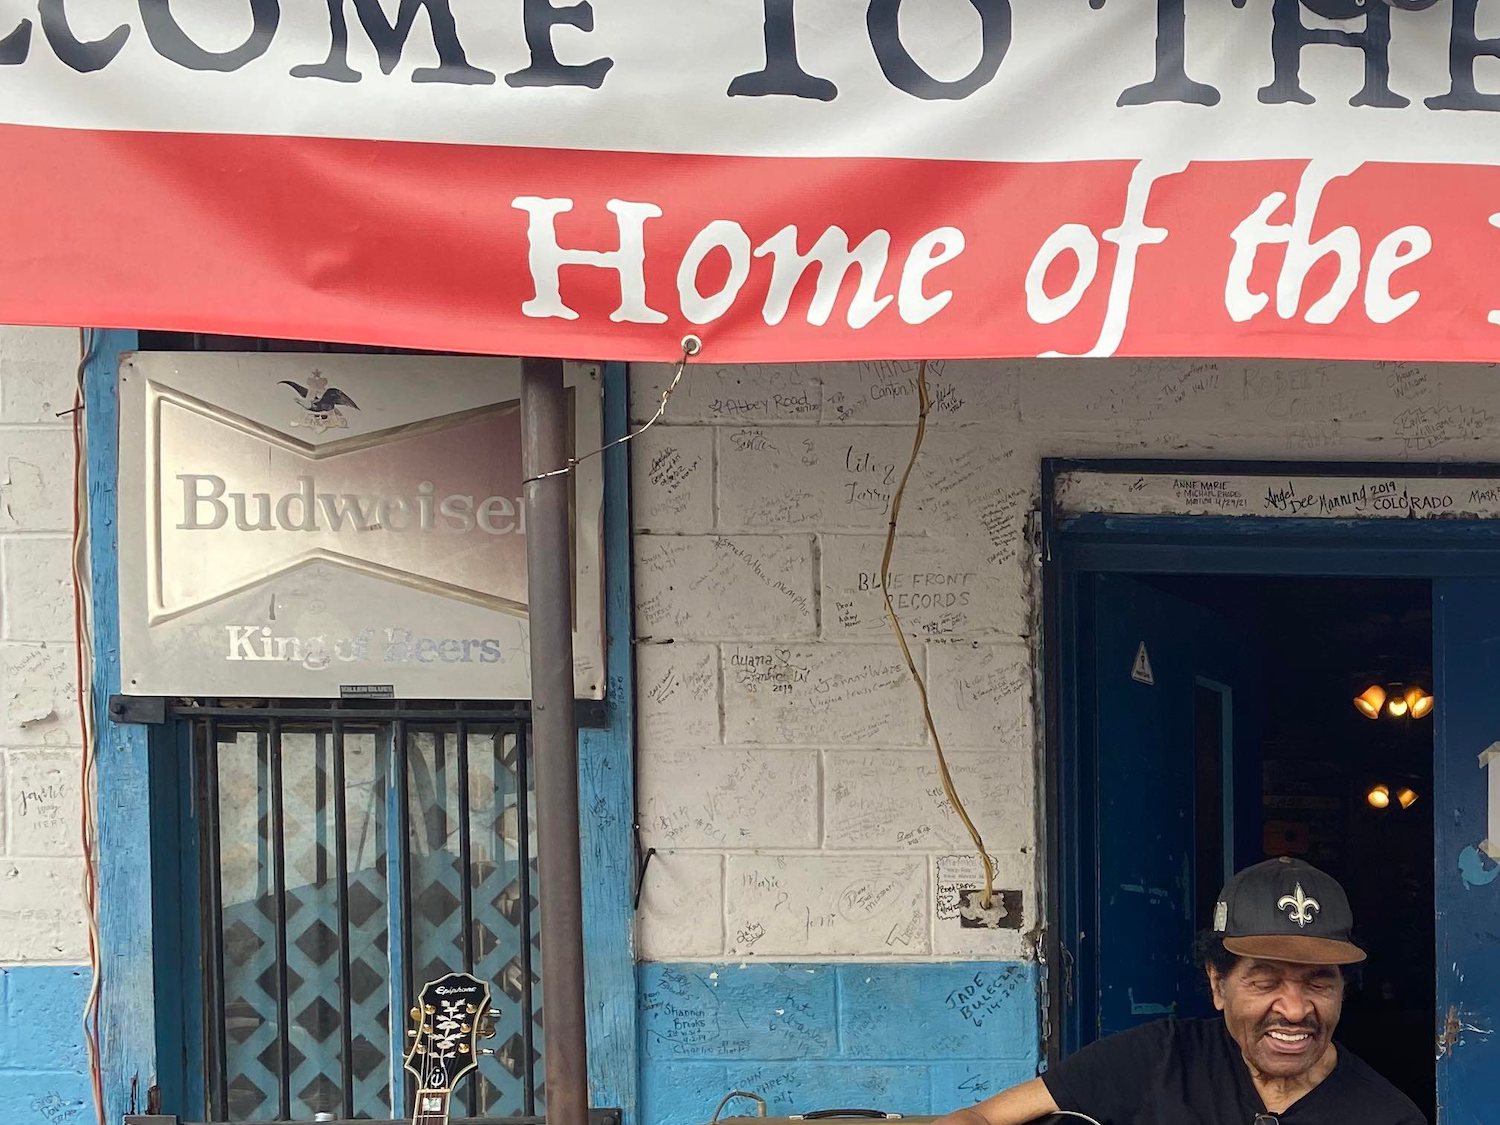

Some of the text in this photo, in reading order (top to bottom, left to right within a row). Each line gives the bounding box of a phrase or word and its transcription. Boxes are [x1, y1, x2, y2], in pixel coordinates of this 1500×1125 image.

[0, 0, 613, 87] COME
[727, 0, 1012, 103] TO
[511, 196, 965, 328] Home
[1025, 157, 1191, 358] of
[1224, 158, 1432, 324] the
[1173, 479, 1230, 490] ANNE MARIE
[1264, 481, 1295, 511] Angel
[1370, 481, 1397, 495] 2019
[1373, 495, 1453, 511] COLORADO
[913, 573, 977, 588] FRONT
[225, 624, 338, 670] King
